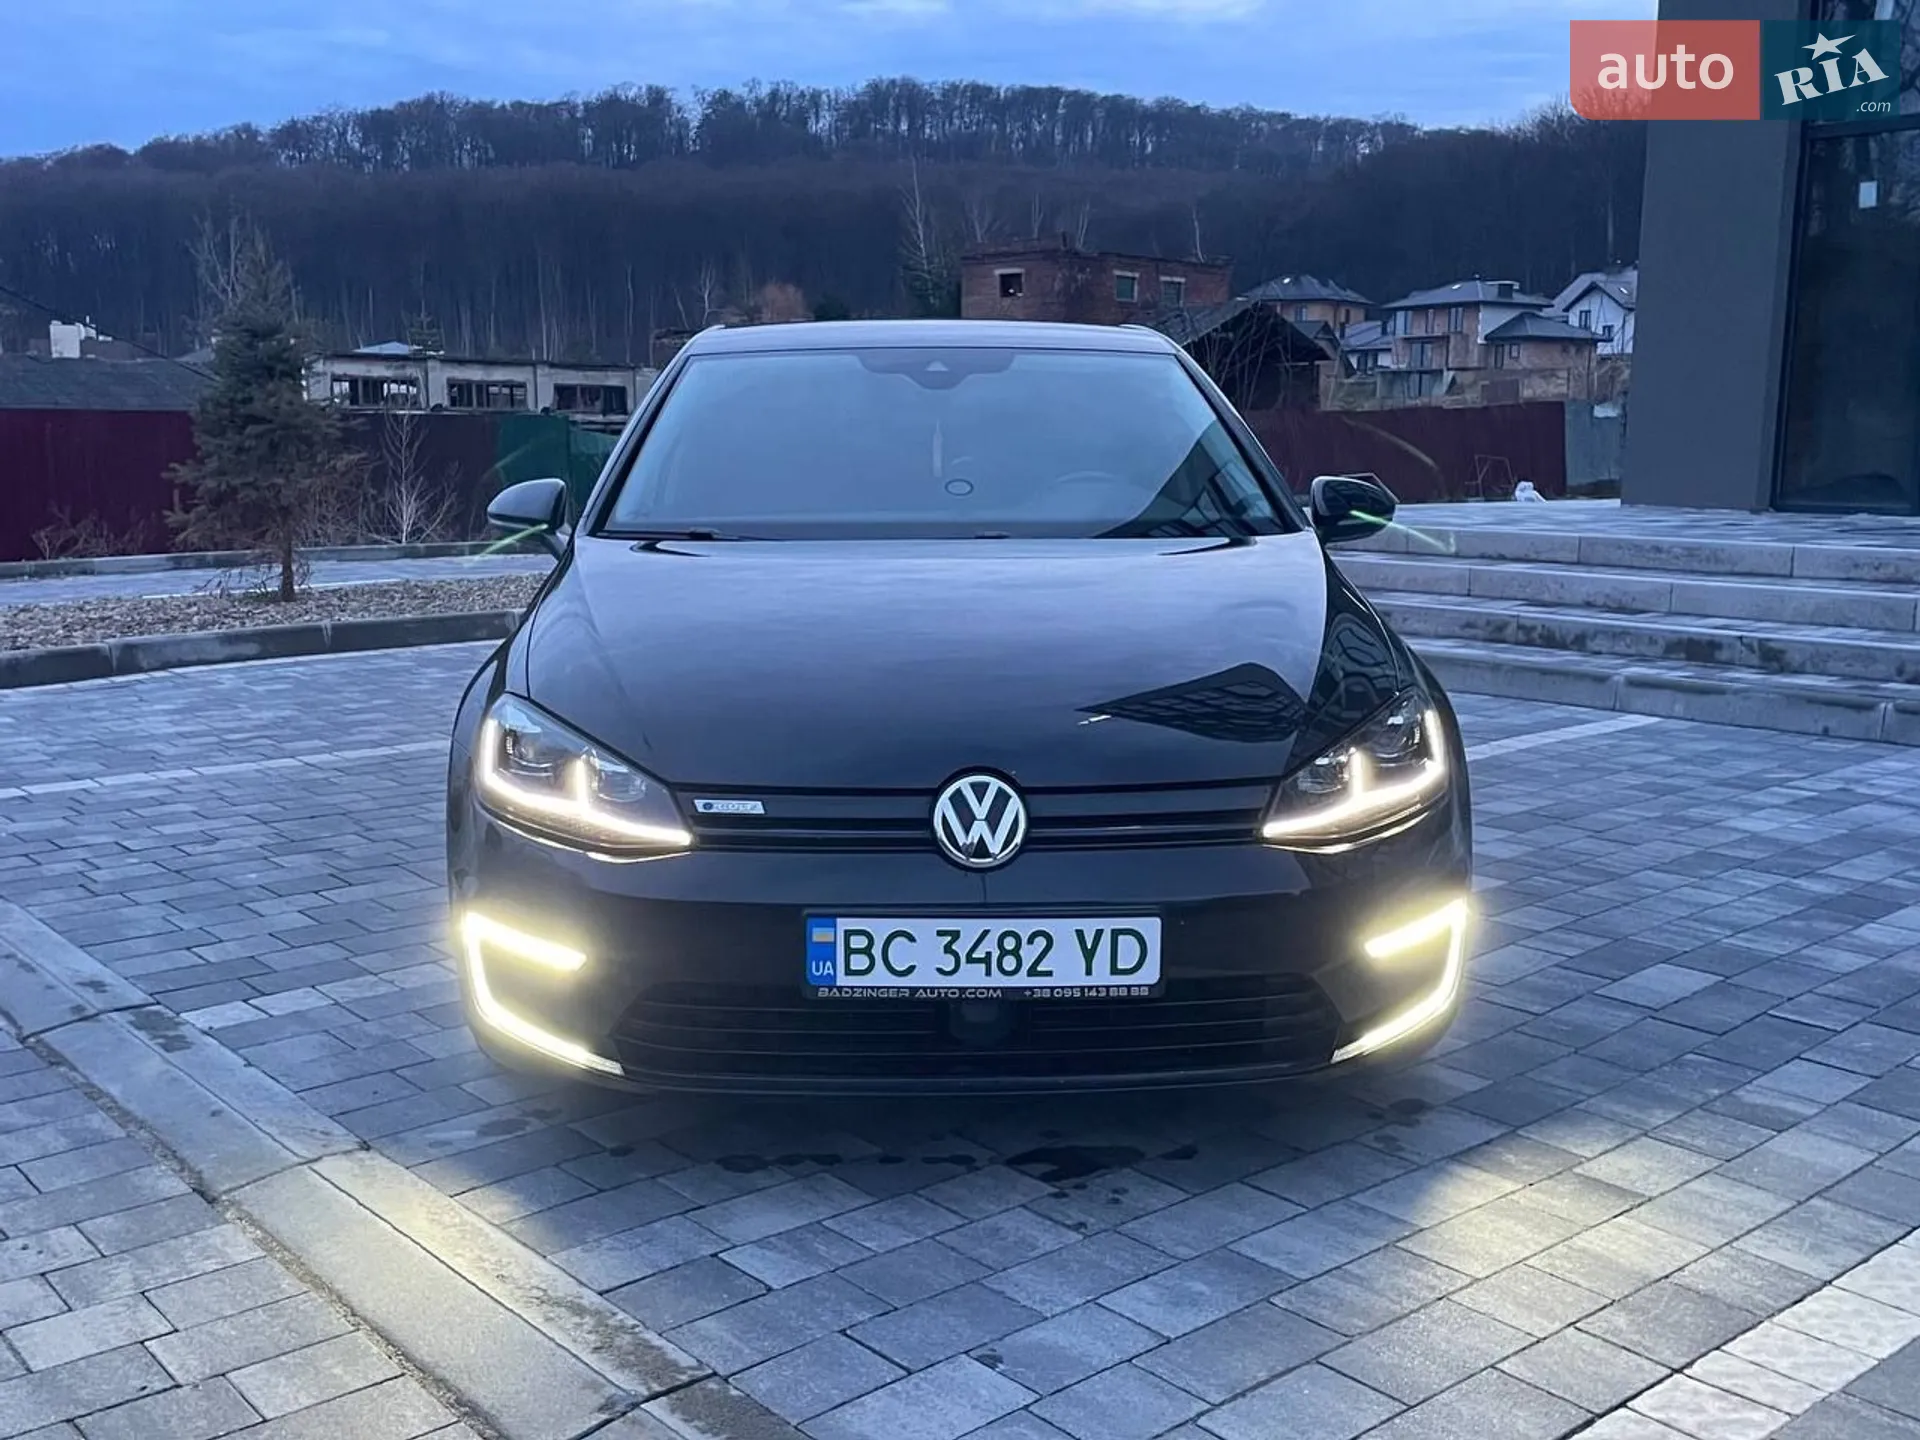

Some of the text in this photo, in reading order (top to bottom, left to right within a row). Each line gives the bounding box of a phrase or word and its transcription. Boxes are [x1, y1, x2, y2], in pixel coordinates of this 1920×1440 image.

[843, 928, 1149, 977] BC 3482 YD
[812, 961, 834, 976] UA
[817, 987, 910, 998] BADZINGER
[1053, 987, 1081, 998] 095
